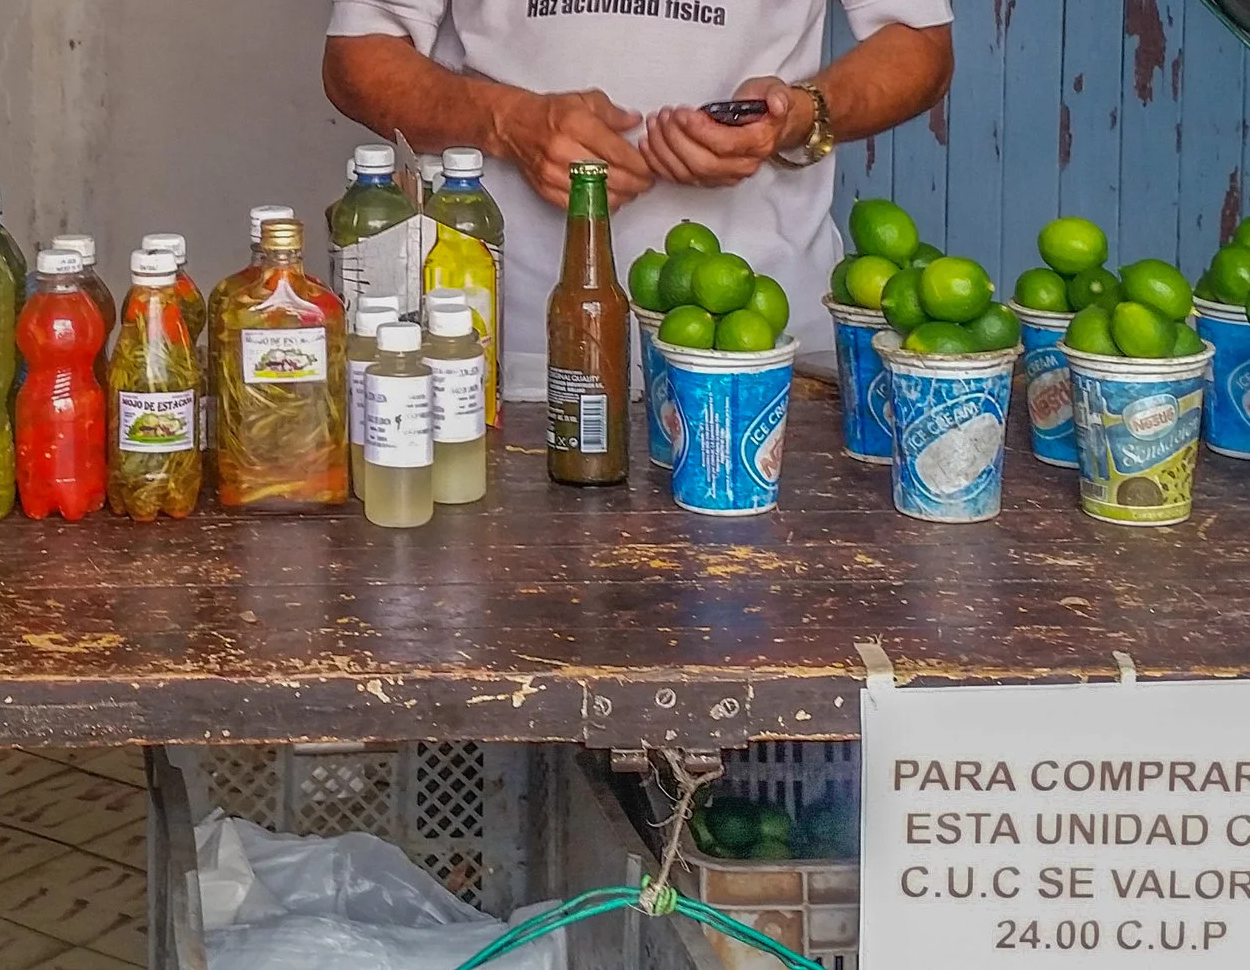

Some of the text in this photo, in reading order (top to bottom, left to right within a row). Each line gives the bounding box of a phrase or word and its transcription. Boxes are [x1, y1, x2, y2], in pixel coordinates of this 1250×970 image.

[144, 401, 156, 412] DE
[750, 421, 768, 445] ICE
[908, 401, 979, 451] ICE CREAM
[894, 759, 1016, 792] PARA
[906, 812, 1021, 845] ESTA
[1036, 813, 1209, 846] UNIDAD
[900, 866, 1020, 899] C.U.C
[1037, 866, 1095, 899] SE
[995, 919, 1228, 951] 24.00 C.U.P
